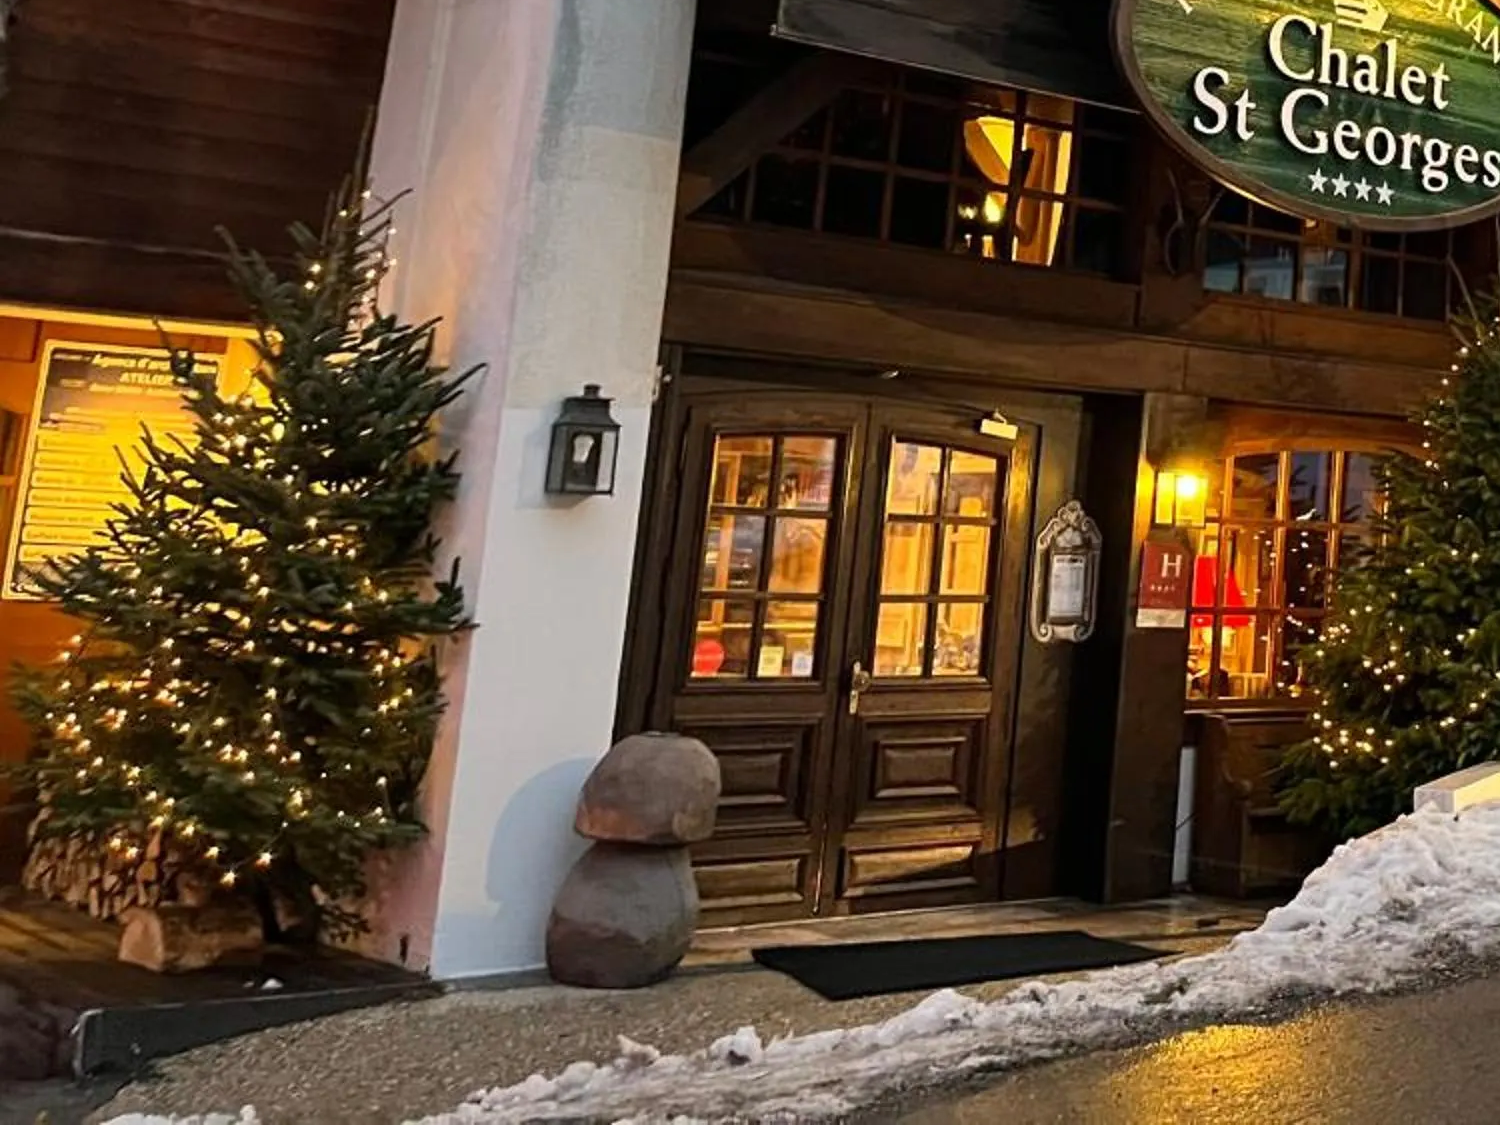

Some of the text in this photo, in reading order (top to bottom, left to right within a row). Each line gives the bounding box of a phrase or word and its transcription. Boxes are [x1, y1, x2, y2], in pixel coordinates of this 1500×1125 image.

[1269, 14, 1451, 110] Chalet
[1192, 66, 1256, 141] St
[1161, 553, 1182, 578] H
